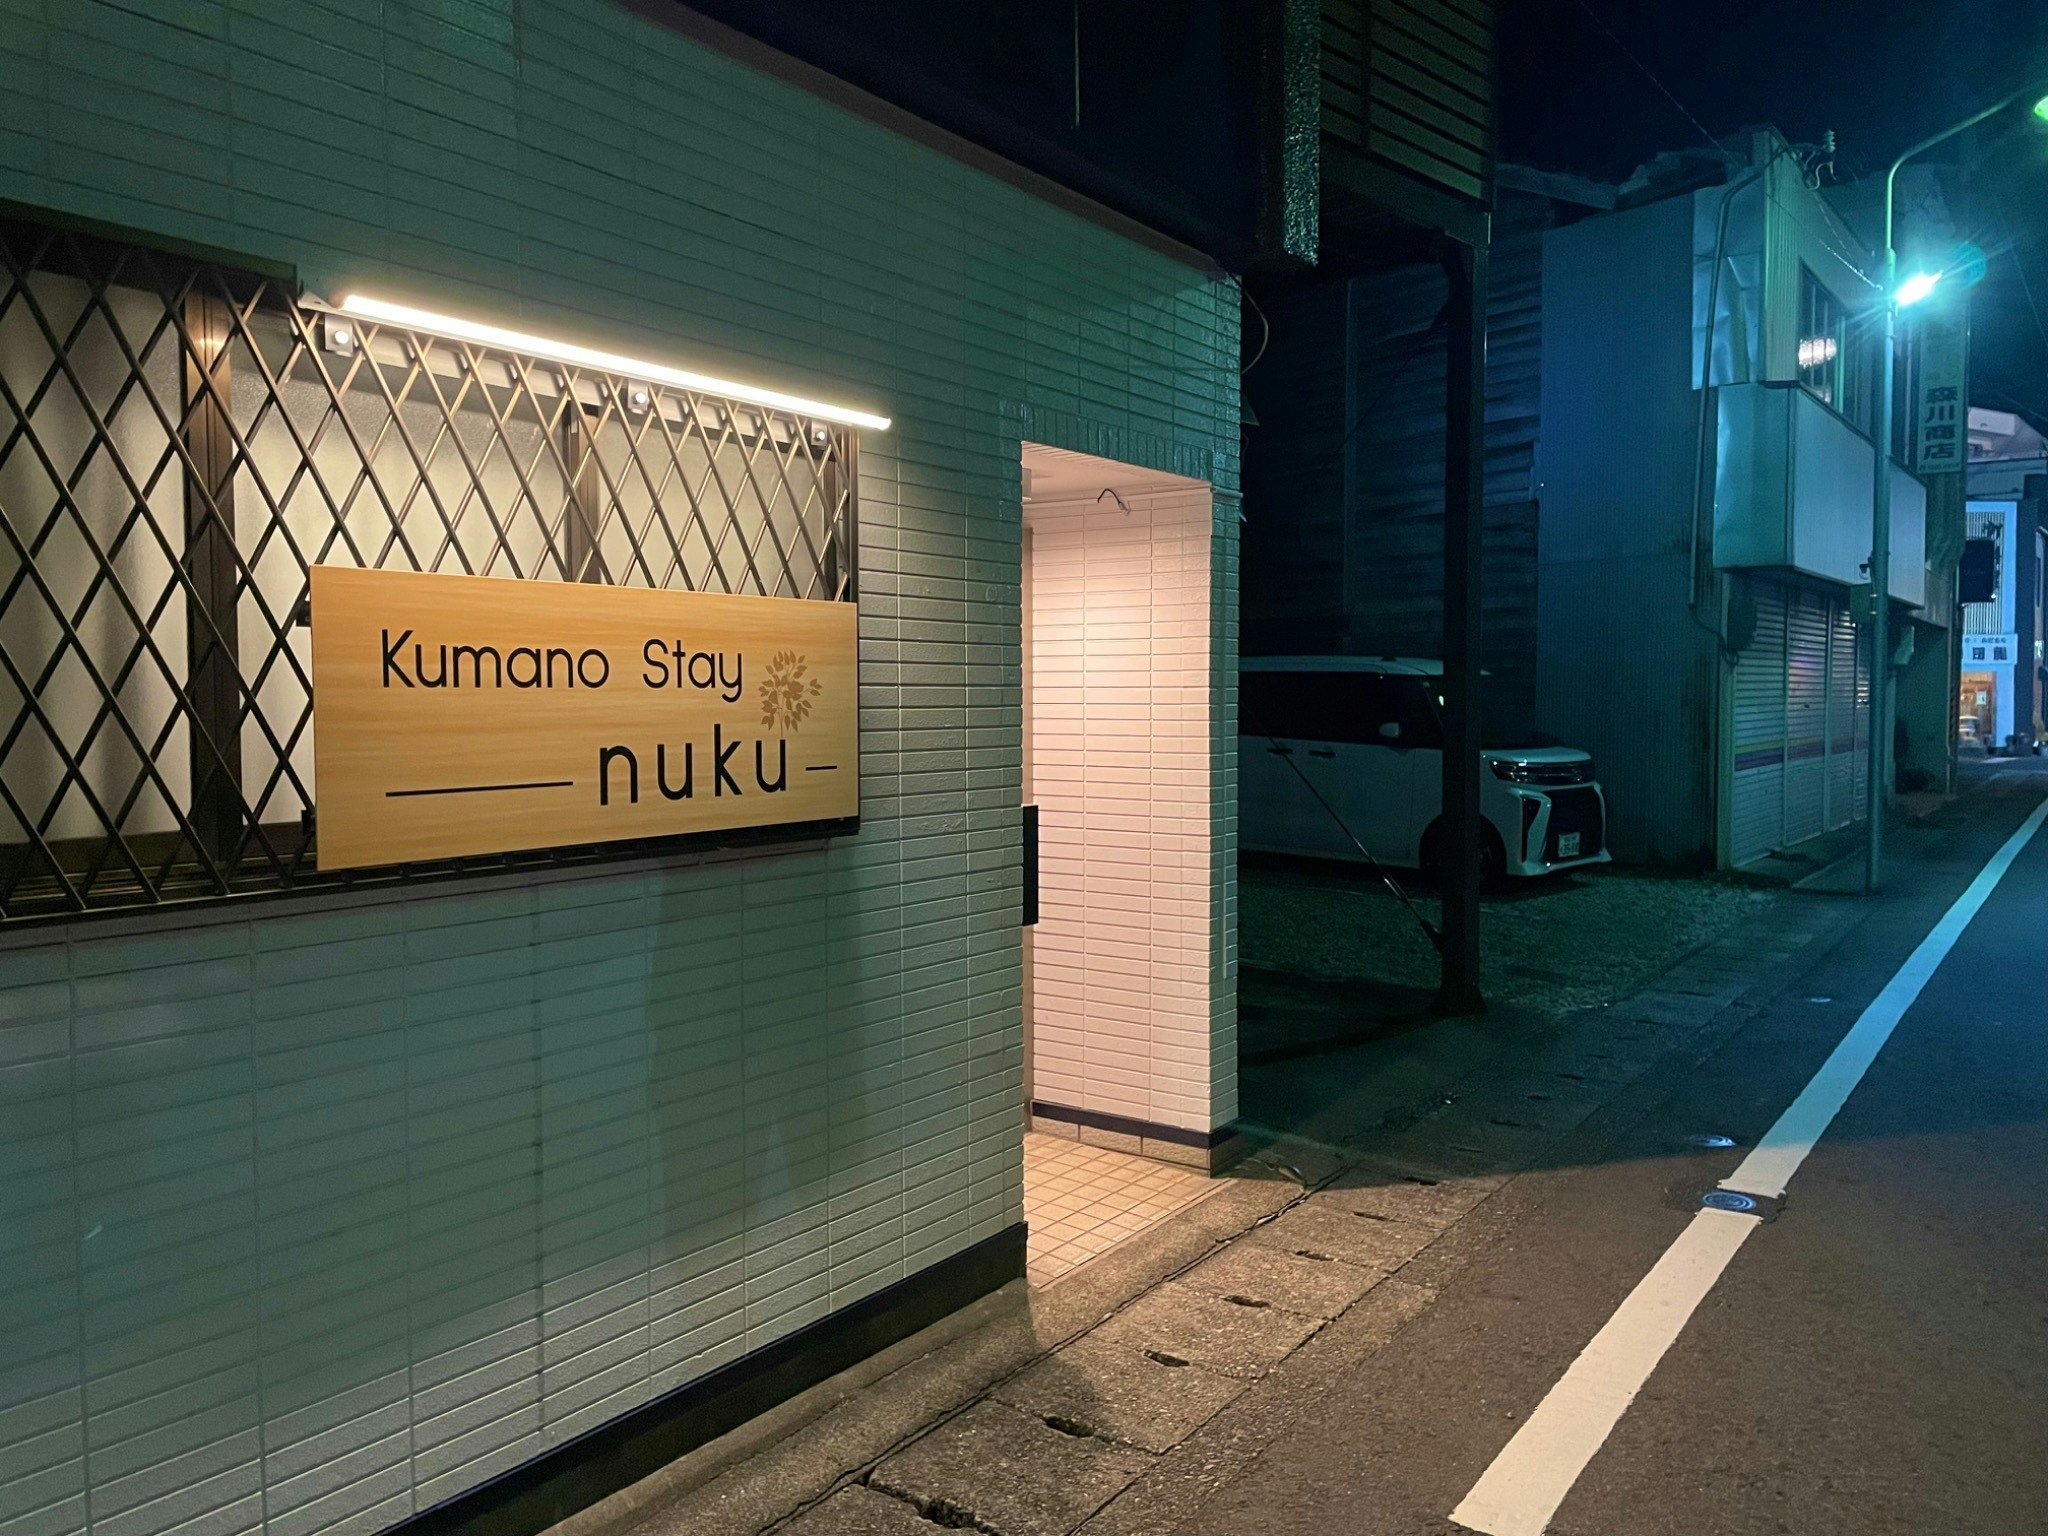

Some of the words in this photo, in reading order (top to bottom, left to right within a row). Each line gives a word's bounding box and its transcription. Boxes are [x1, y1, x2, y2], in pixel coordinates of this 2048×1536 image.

[381, 629, 609, 688] Kumano
[643, 639, 742, 703] Stay
[600, 724, 786, 806] nuku
